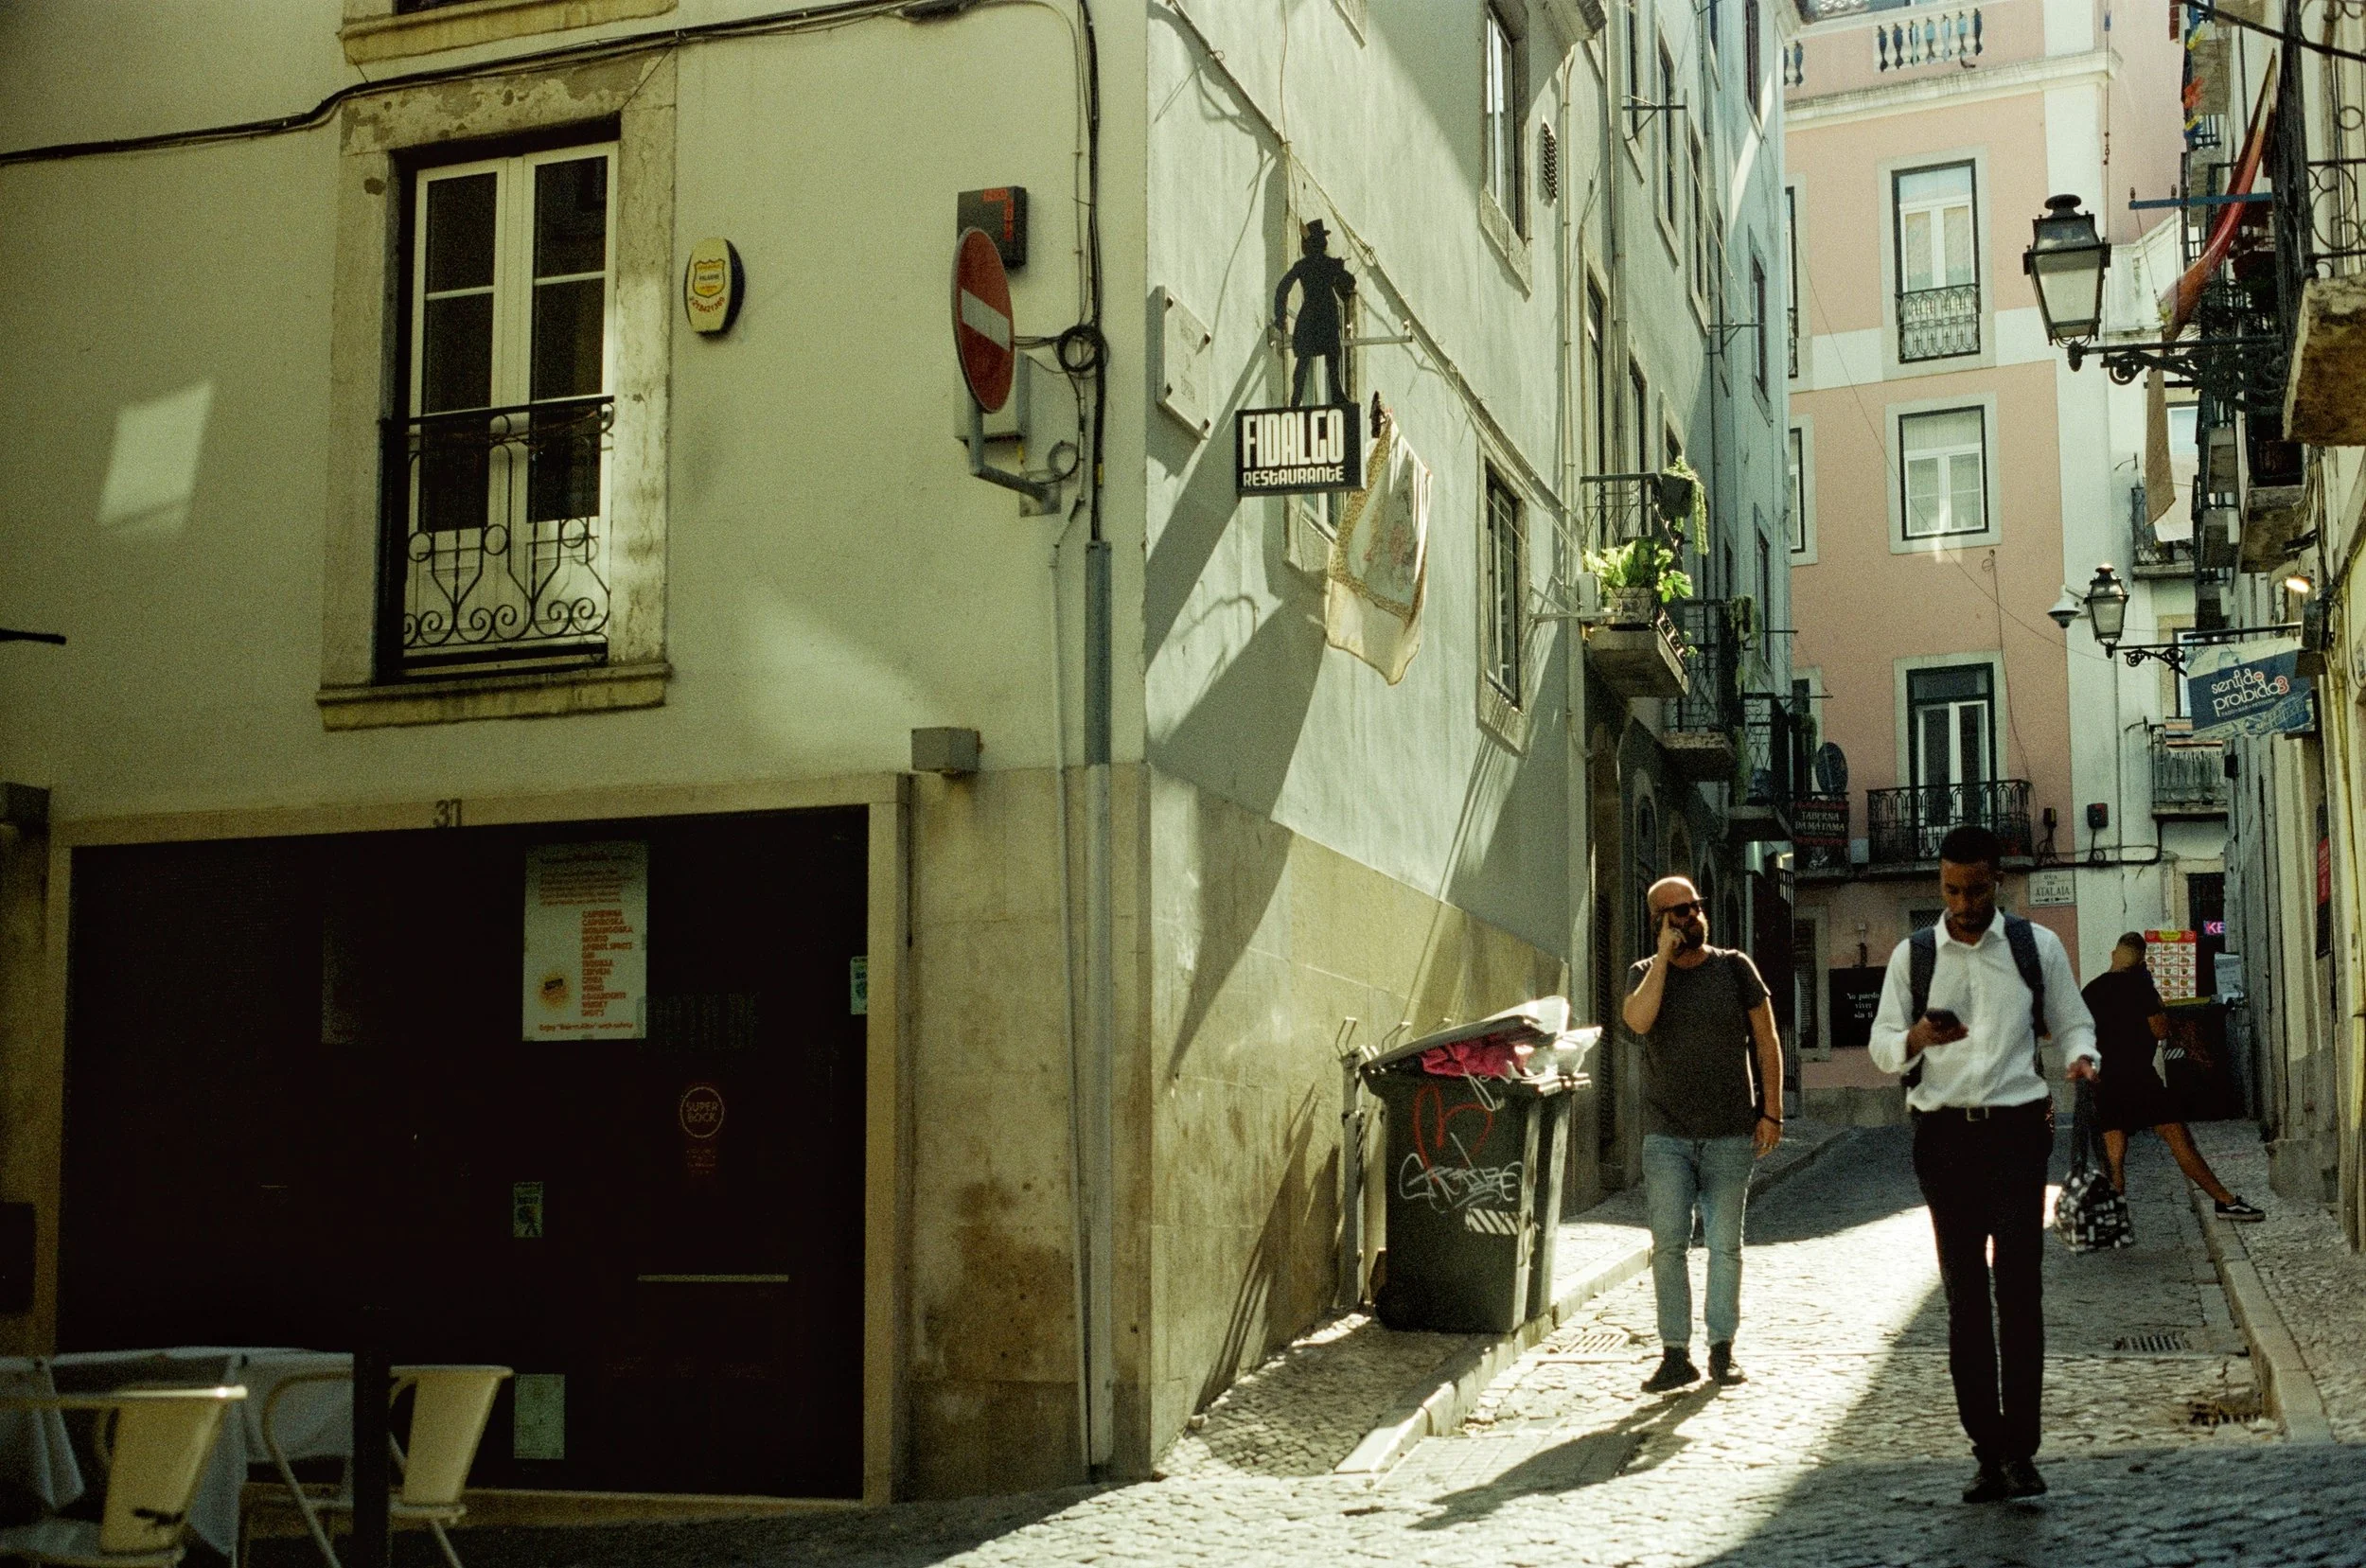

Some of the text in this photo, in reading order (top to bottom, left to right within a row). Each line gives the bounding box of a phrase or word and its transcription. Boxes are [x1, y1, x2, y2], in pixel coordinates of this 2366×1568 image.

[1243, 408, 1344, 468] FIDALGO
[2211, 667, 2265, 695] sentido
[2212, 679, 2280, 717] proibido
[433, 798, 463, 828] 31
[1801, 810, 1840, 821] TABERNA
[2035, 886, 2071, 898] ATALAIA
[685, 1101, 719, 1112] SUPER
[687, 1112, 717, 1123] BOCK
